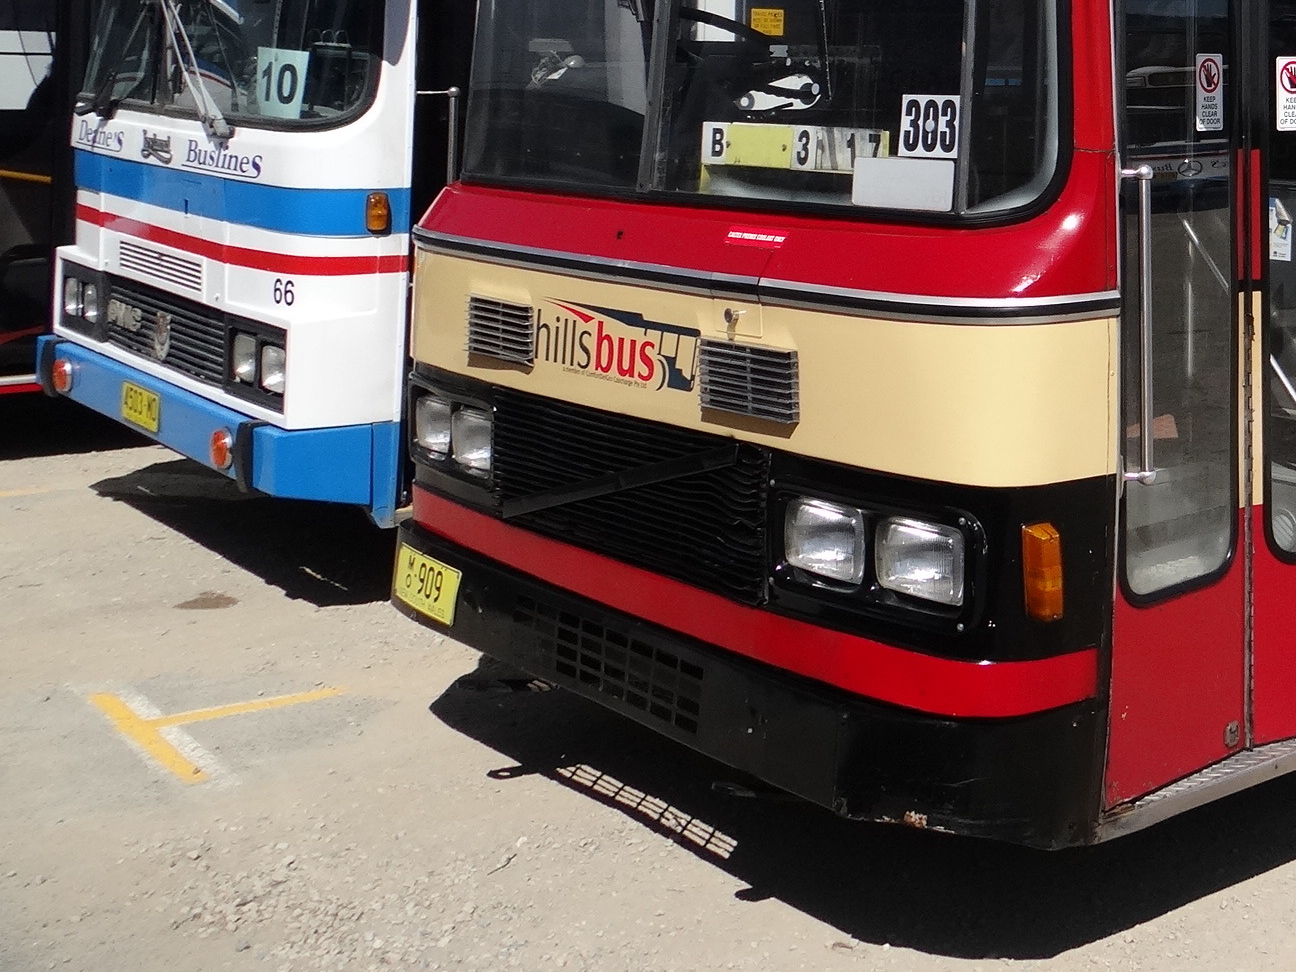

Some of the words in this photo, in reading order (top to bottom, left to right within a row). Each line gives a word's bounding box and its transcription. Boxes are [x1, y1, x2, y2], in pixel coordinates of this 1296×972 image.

[262, 61, 298, 105] 10
[711, 128, 724, 157] B
[273, 278, 295, 307] 66
[534, 308, 656, 382] hillsbus
[417, 562, 444, 603] 909
